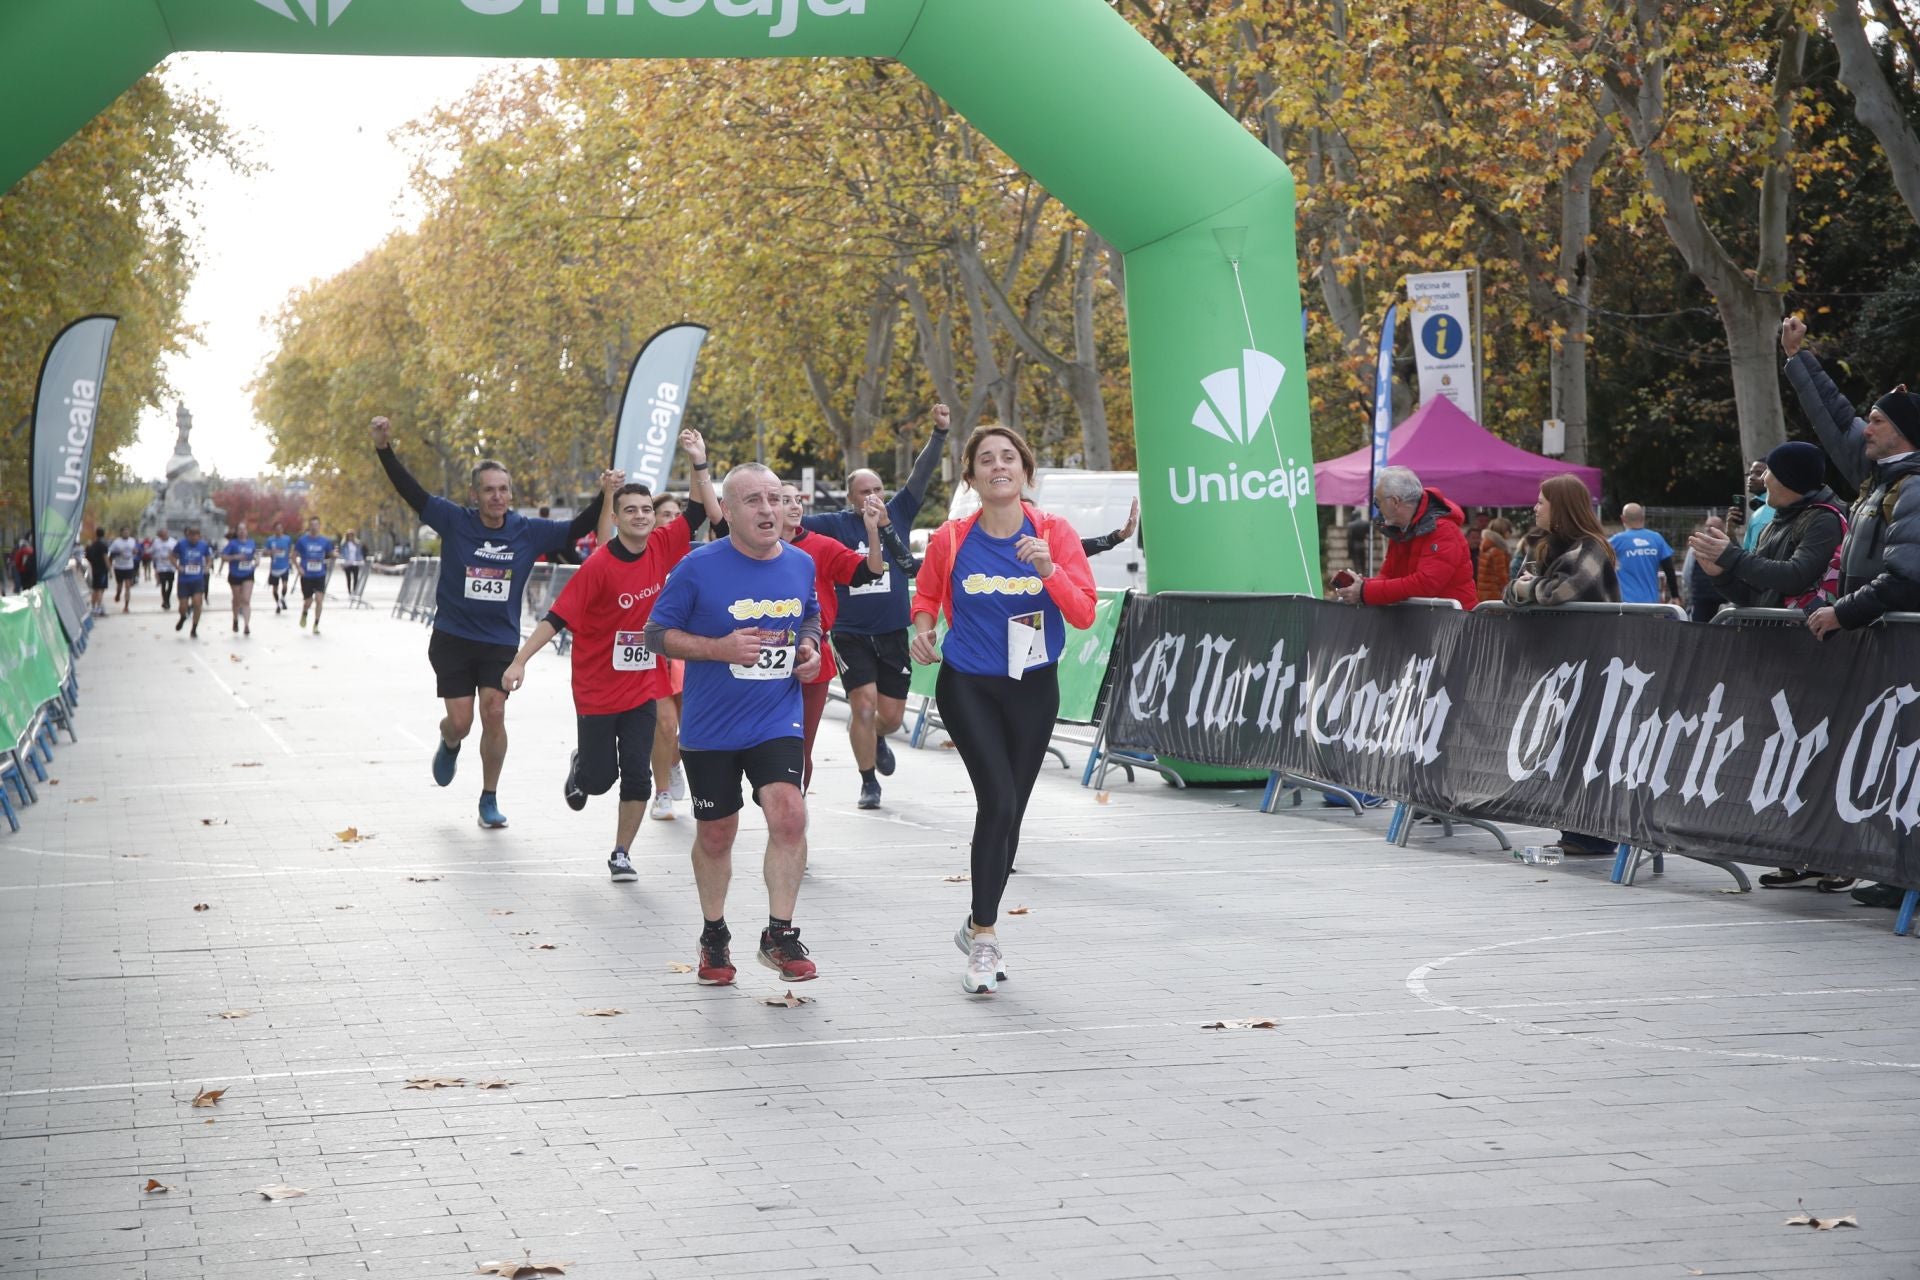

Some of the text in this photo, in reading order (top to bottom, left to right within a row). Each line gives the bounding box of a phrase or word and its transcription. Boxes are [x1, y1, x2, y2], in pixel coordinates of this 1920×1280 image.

[56, 378, 96, 501] Unicaja
[1168, 458, 1310, 509] Unicaja
[474, 550, 514, 561] MICHELIN
[1626, 548, 1658, 558] IVECO
[471, 580, 503, 594] 643
[624, 647, 650, 662] 965
[743, 648, 787, 669] 32
[1507, 659, 1588, 783] El
[1582, 656, 1745, 809] Norte
[1747, 688, 1830, 818] de
